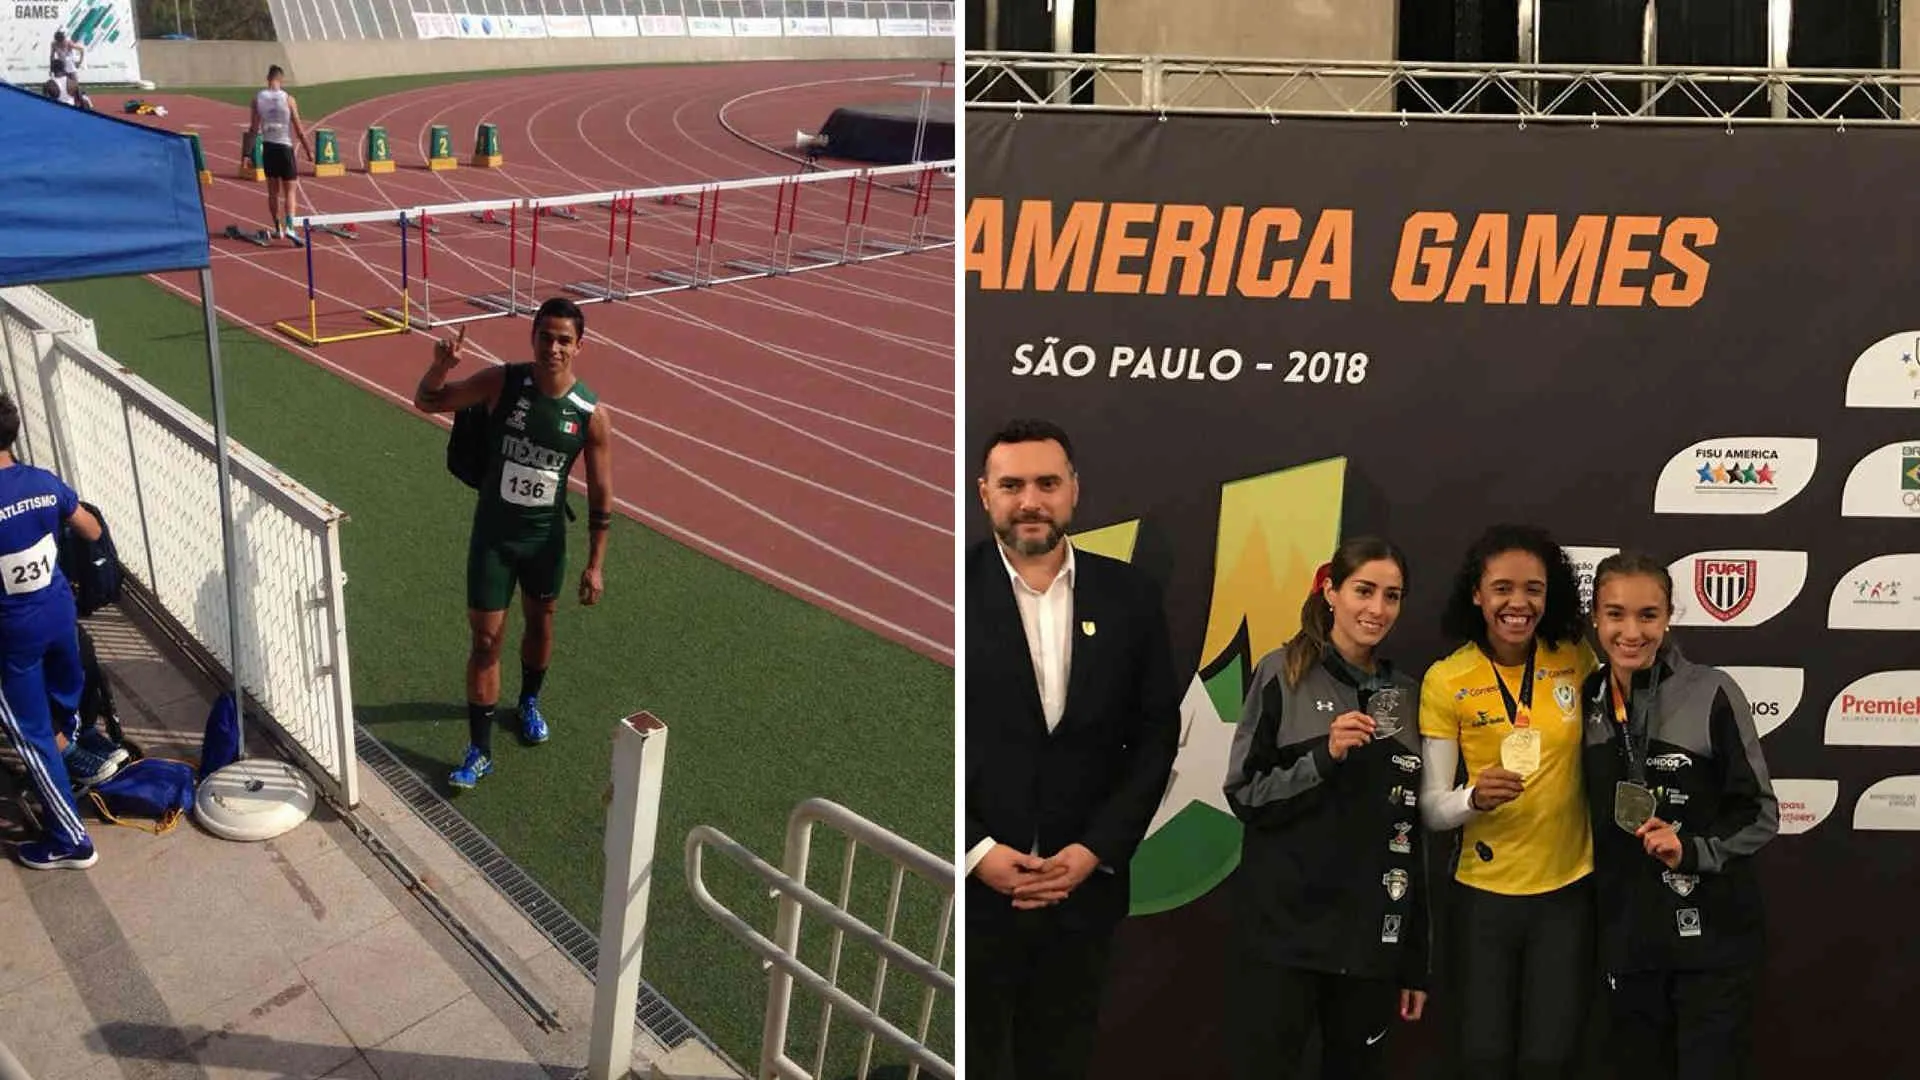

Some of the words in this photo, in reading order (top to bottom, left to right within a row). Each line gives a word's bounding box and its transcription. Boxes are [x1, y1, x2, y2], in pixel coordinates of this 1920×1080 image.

[15, 5, 59, 19] GAMES
[324, 141, 334, 162] 4
[376, 139, 386, 157] 3
[439, 137, 449, 154] 2
[965, 198, 1352, 300] AMERICA
[1391, 211, 1719, 308] GAMES
[1011, 336, 1096, 377] SÃO
[1108, 346, 1243, 382] PAULO
[1284, 351, 1369, 385] 2018
[1695, 449, 1722, 458] FISU
[1725, 449, 1779, 459] AMERICA
[508, 476, 545, 498] 136
[0, 494, 57, 521] ATLETISMO
[11, 554, 50, 585] 231
[1706, 563, 1745, 576] FUPE
